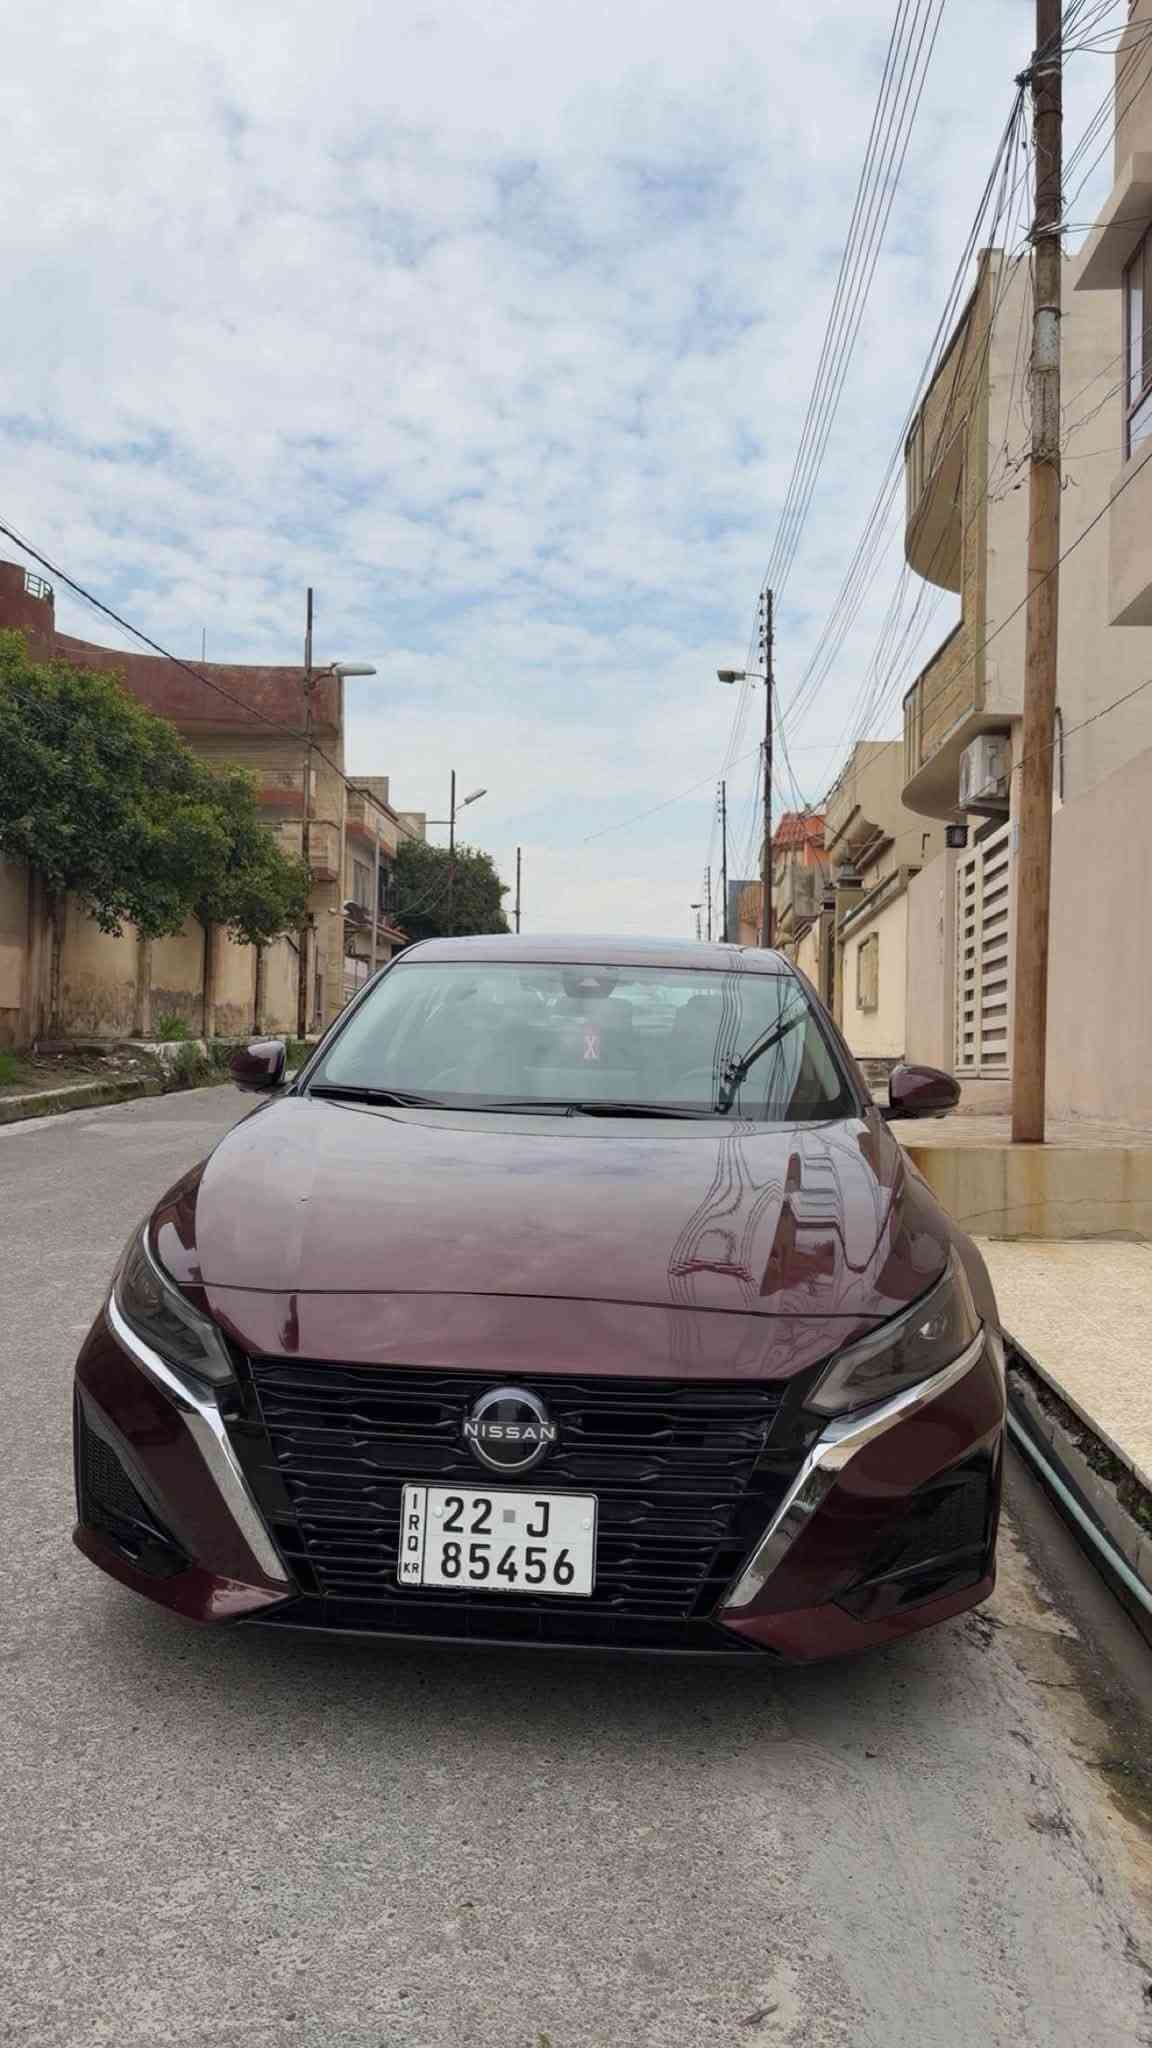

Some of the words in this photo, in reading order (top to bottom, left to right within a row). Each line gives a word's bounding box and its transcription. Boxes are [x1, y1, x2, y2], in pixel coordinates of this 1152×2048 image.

[463, 1422, 556, 1440] NISSAN
[407, 1492, 420, 1553] IRQ
[442, 1496, 493, 1535] 22
[526, 1501, 550, 1538] J
[403, 1562, 420, 1574] KR
[440, 1541, 575, 1586] 85456
